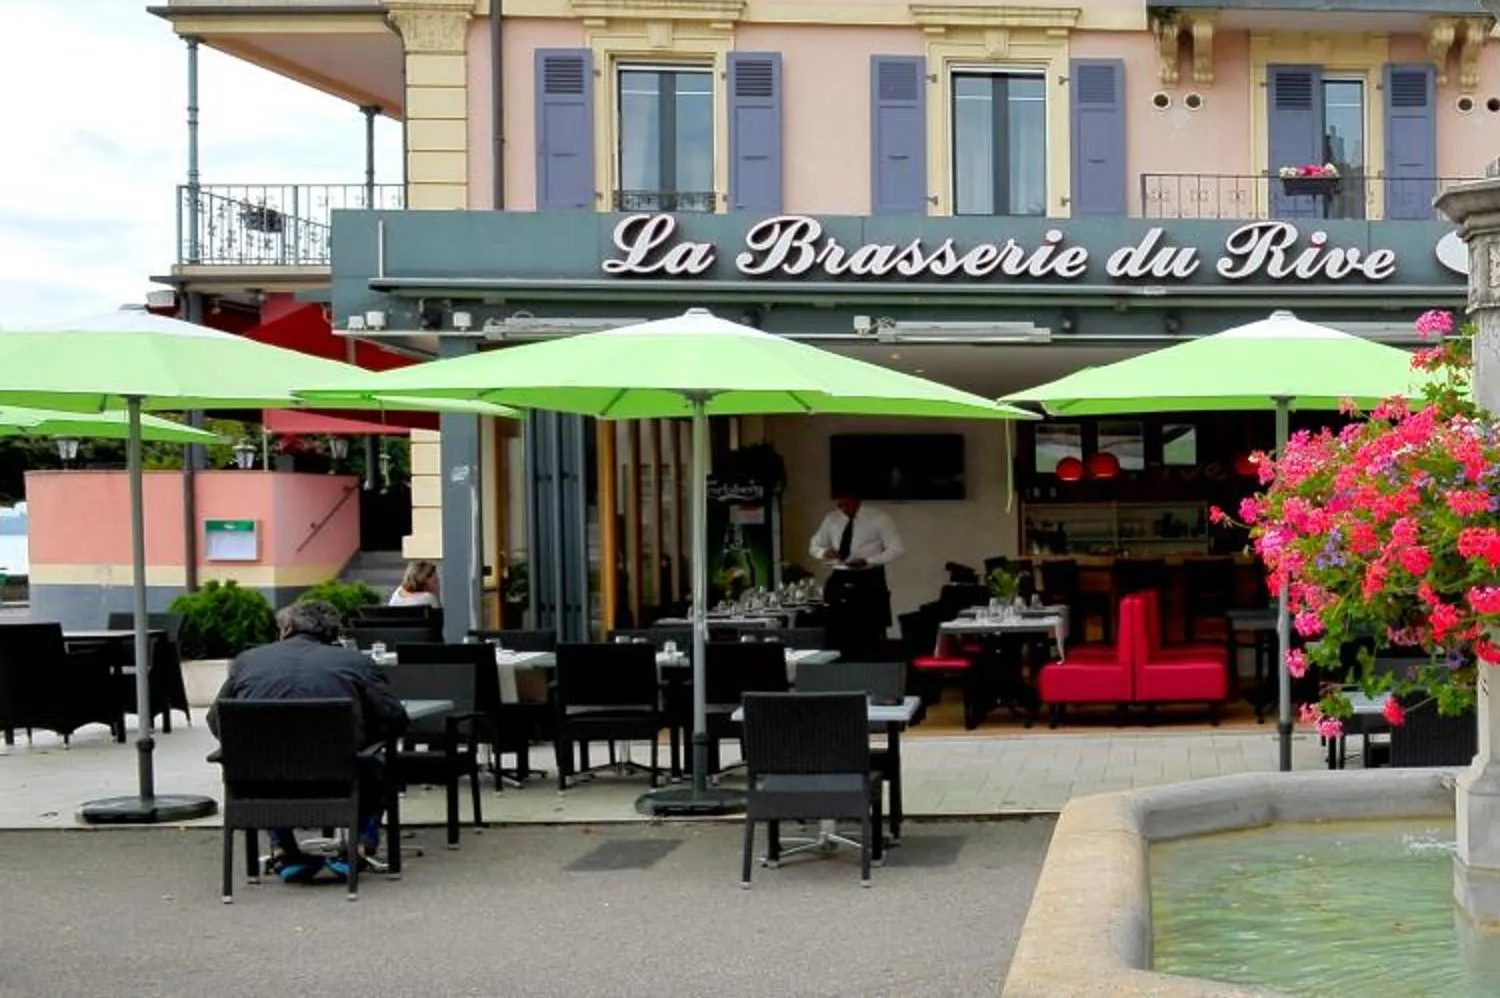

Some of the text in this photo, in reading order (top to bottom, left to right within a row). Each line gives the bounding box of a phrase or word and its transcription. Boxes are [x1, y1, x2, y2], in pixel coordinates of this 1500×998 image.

[601, 213, 1397, 279] La Brasserie du Rive
